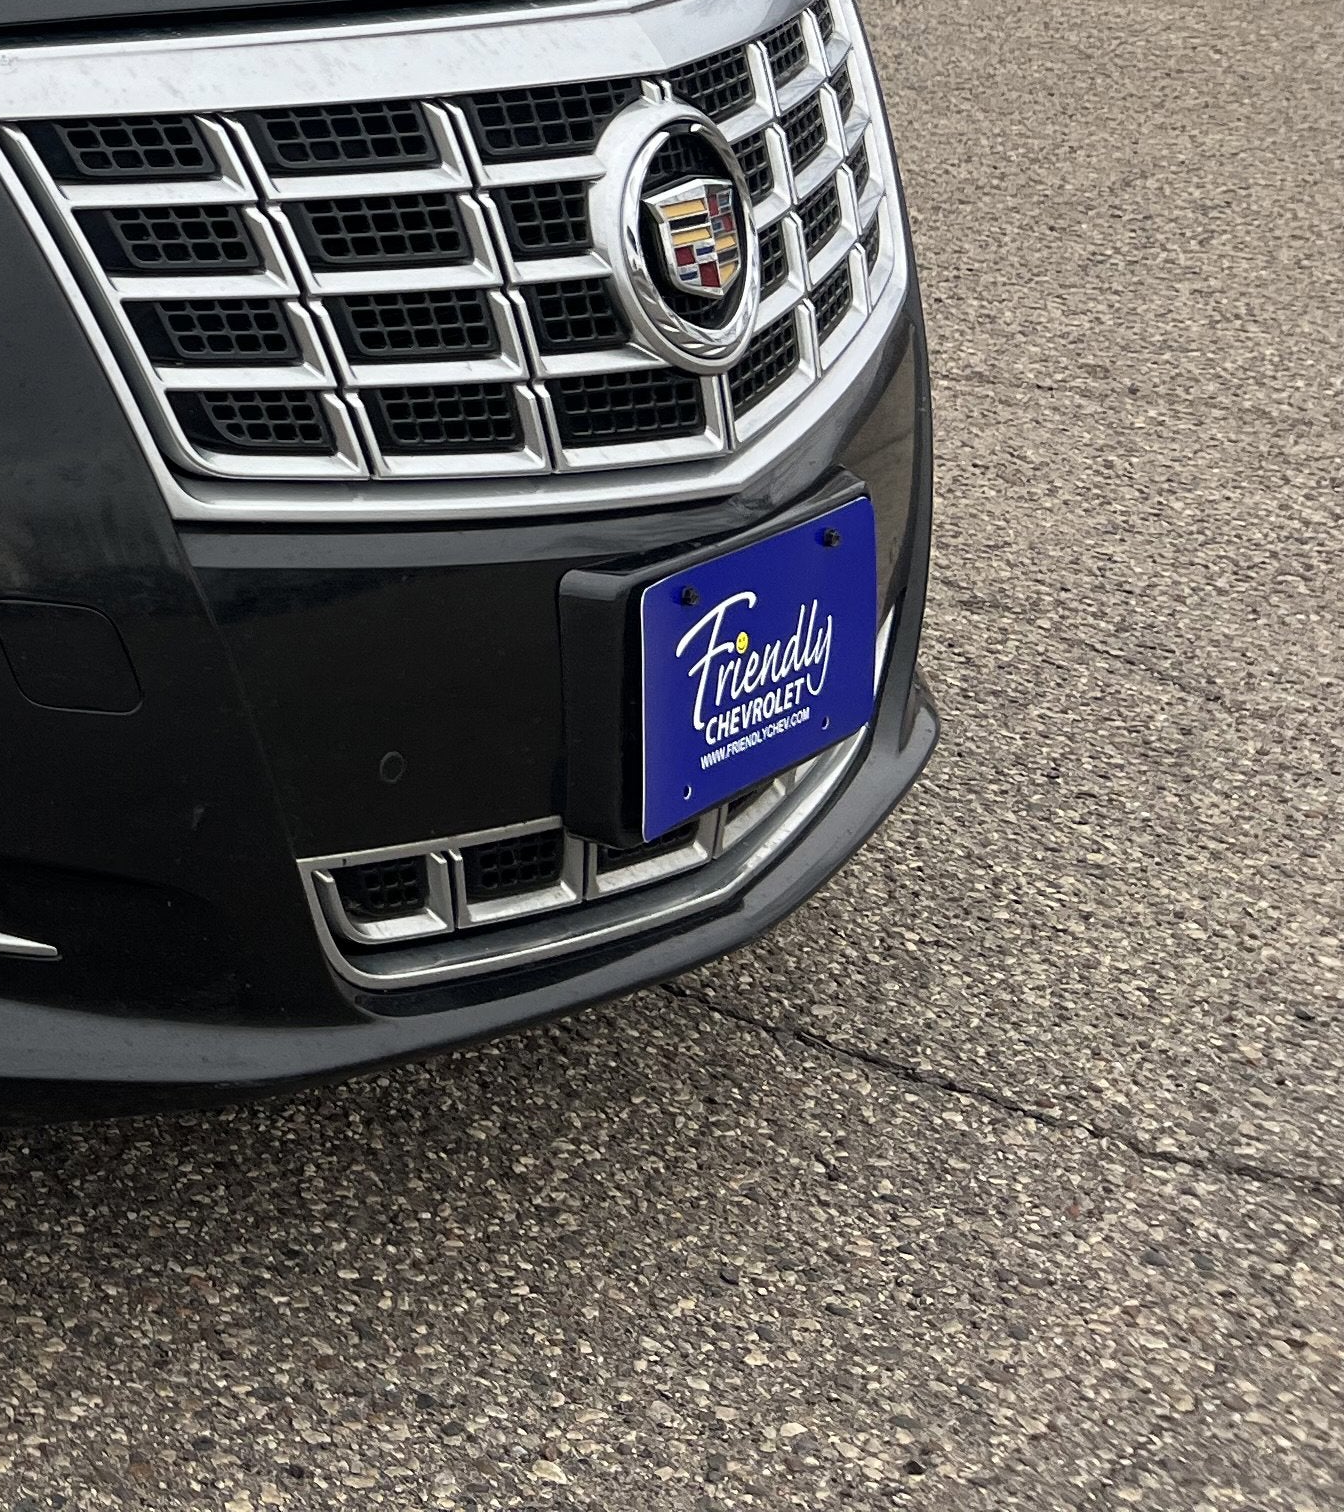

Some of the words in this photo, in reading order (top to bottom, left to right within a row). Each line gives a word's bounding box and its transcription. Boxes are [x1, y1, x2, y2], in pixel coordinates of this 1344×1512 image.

[676, 591, 833, 731] Friendly
[700, 706, 811, 770] WWW.FRIENDLYCHEV.COM
[705, 677, 805, 745] CHEVROLET
